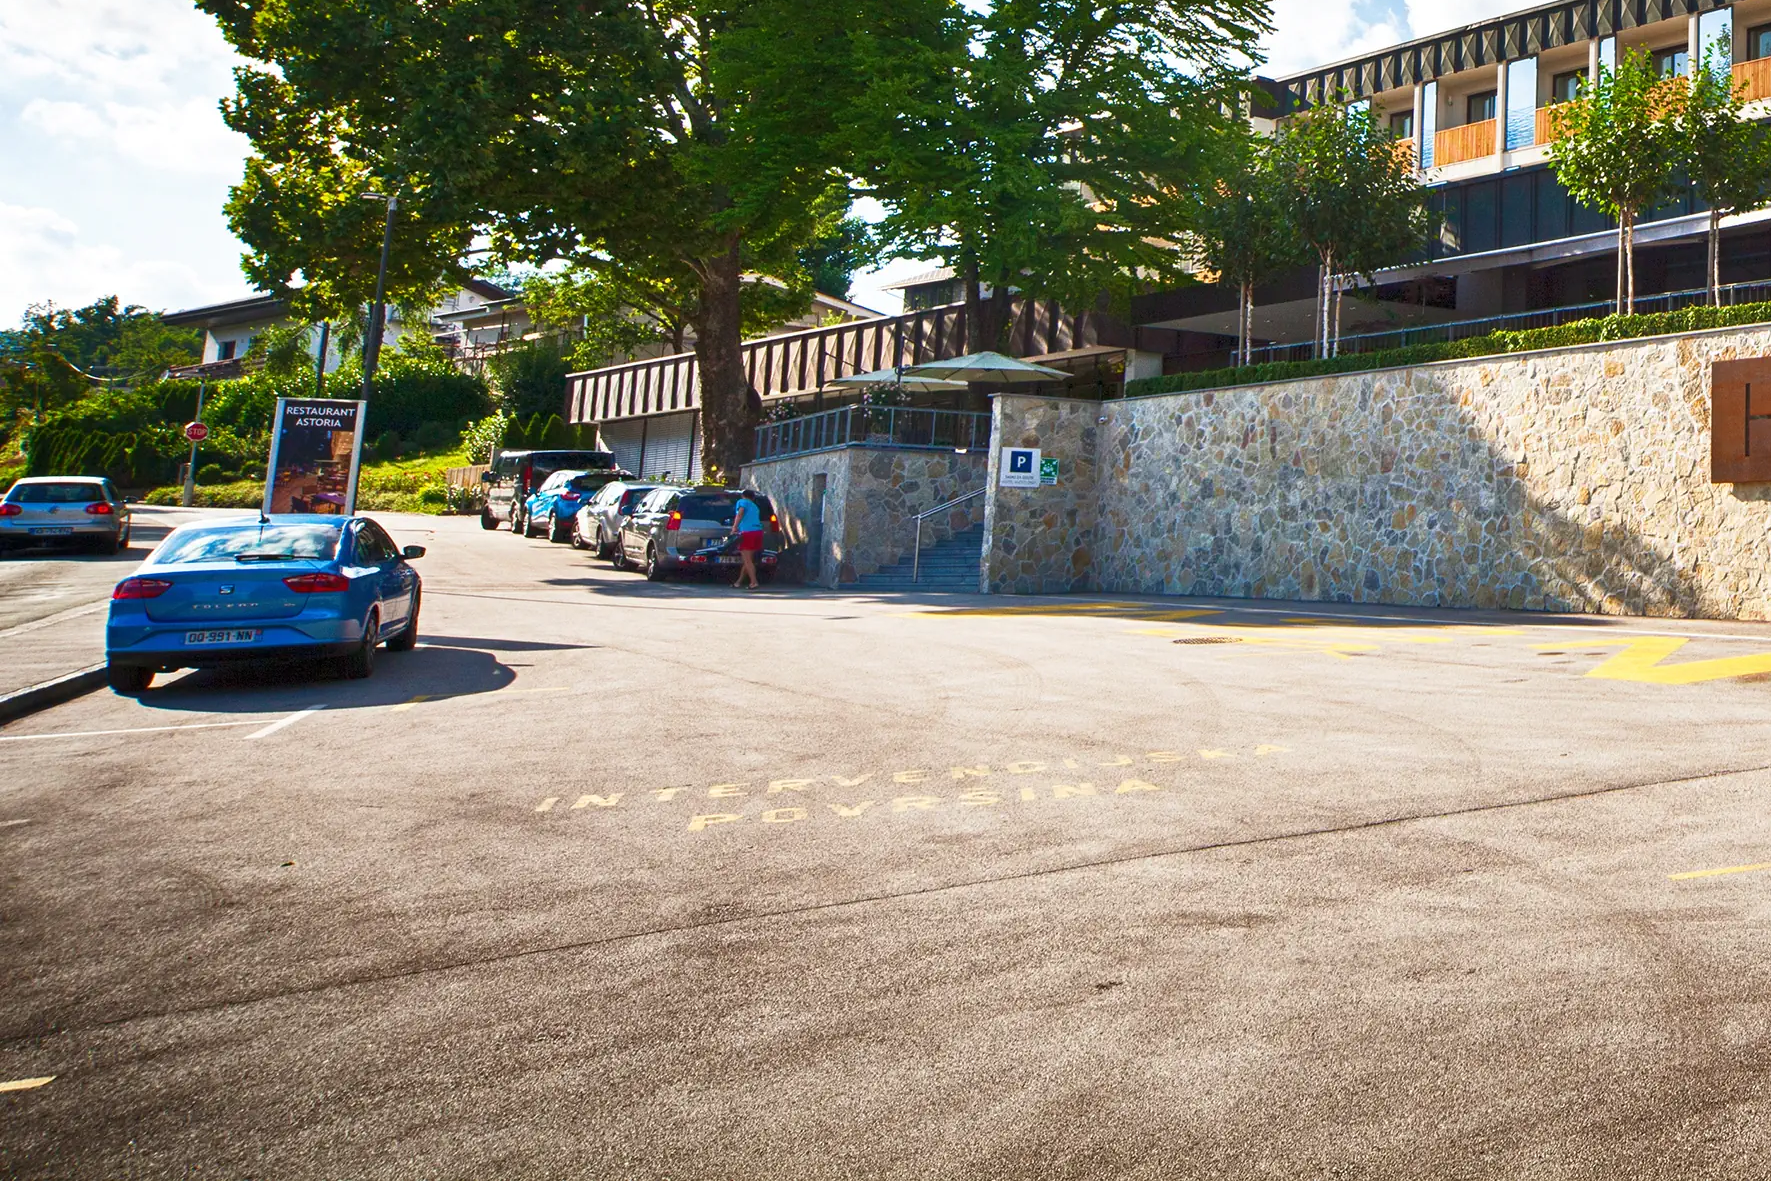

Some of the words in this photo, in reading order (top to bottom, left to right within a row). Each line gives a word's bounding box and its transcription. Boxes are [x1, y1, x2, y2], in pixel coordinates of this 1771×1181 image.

[286, 406, 356, 417] RESTAURANT
[296, 418, 342, 427] ASTORIA
[1018, 456, 1026, 468] P
